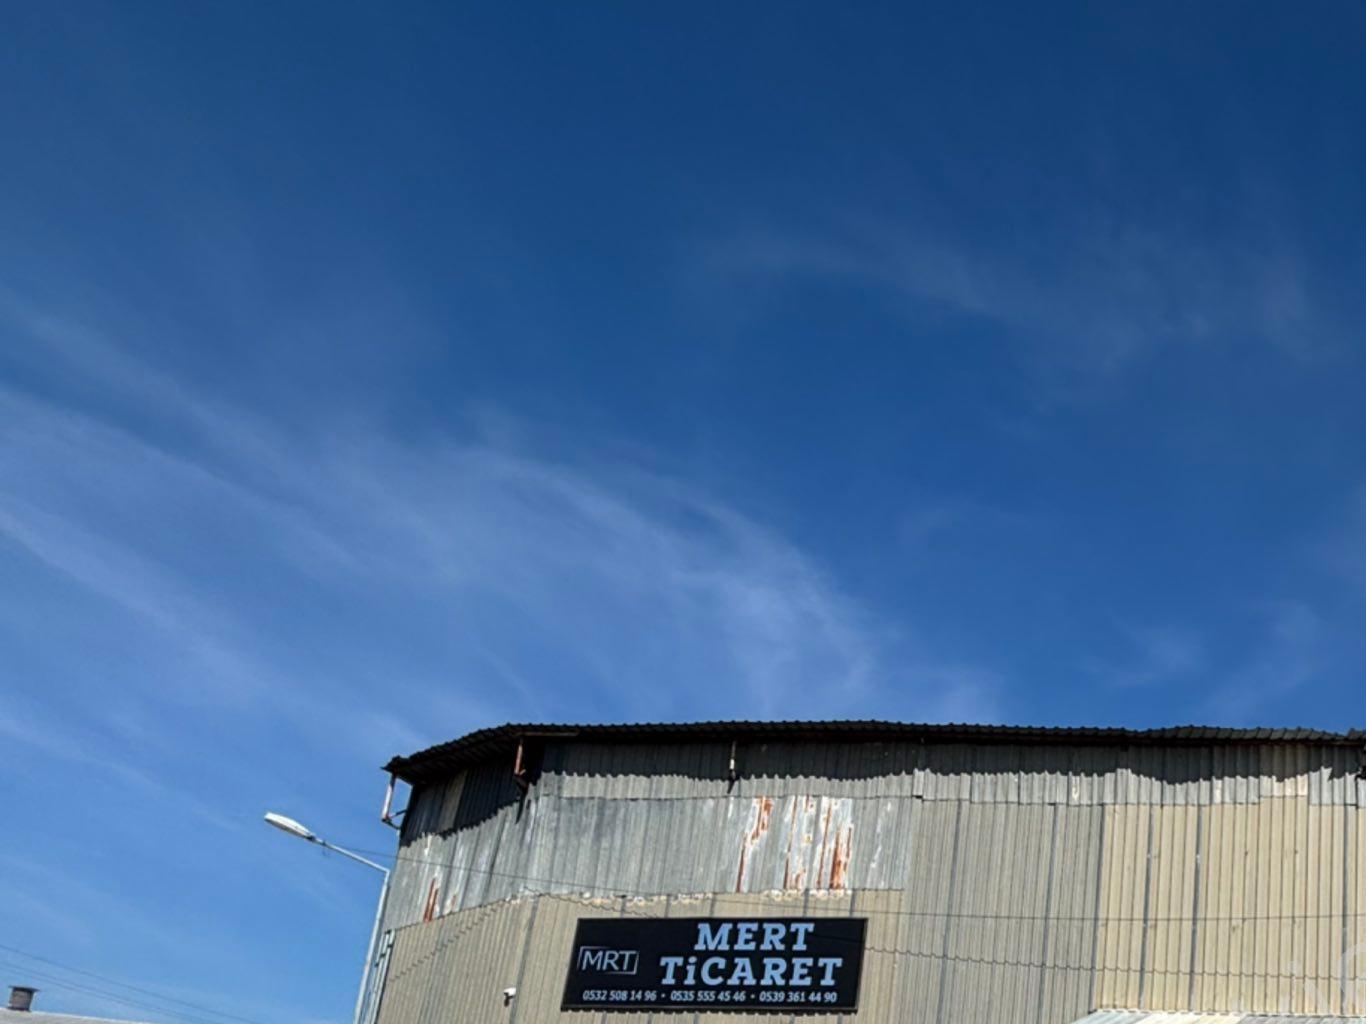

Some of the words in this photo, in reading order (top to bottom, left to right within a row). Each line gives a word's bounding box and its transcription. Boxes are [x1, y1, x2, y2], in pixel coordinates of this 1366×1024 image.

[694, 922, 815, 951] MERT
[581, 951, 638, 973] MRT
[582, 990, 609, 1001] 0532
[630, 990, 643, 1001] 14
[644, 990, 657, 1001] 96
[670, 990, 695, 1001] 0535
[717, 991, 731, 1001] 45
[759, 991, 785, 1002] 0539
[823, 992, 837, 1003] 90
